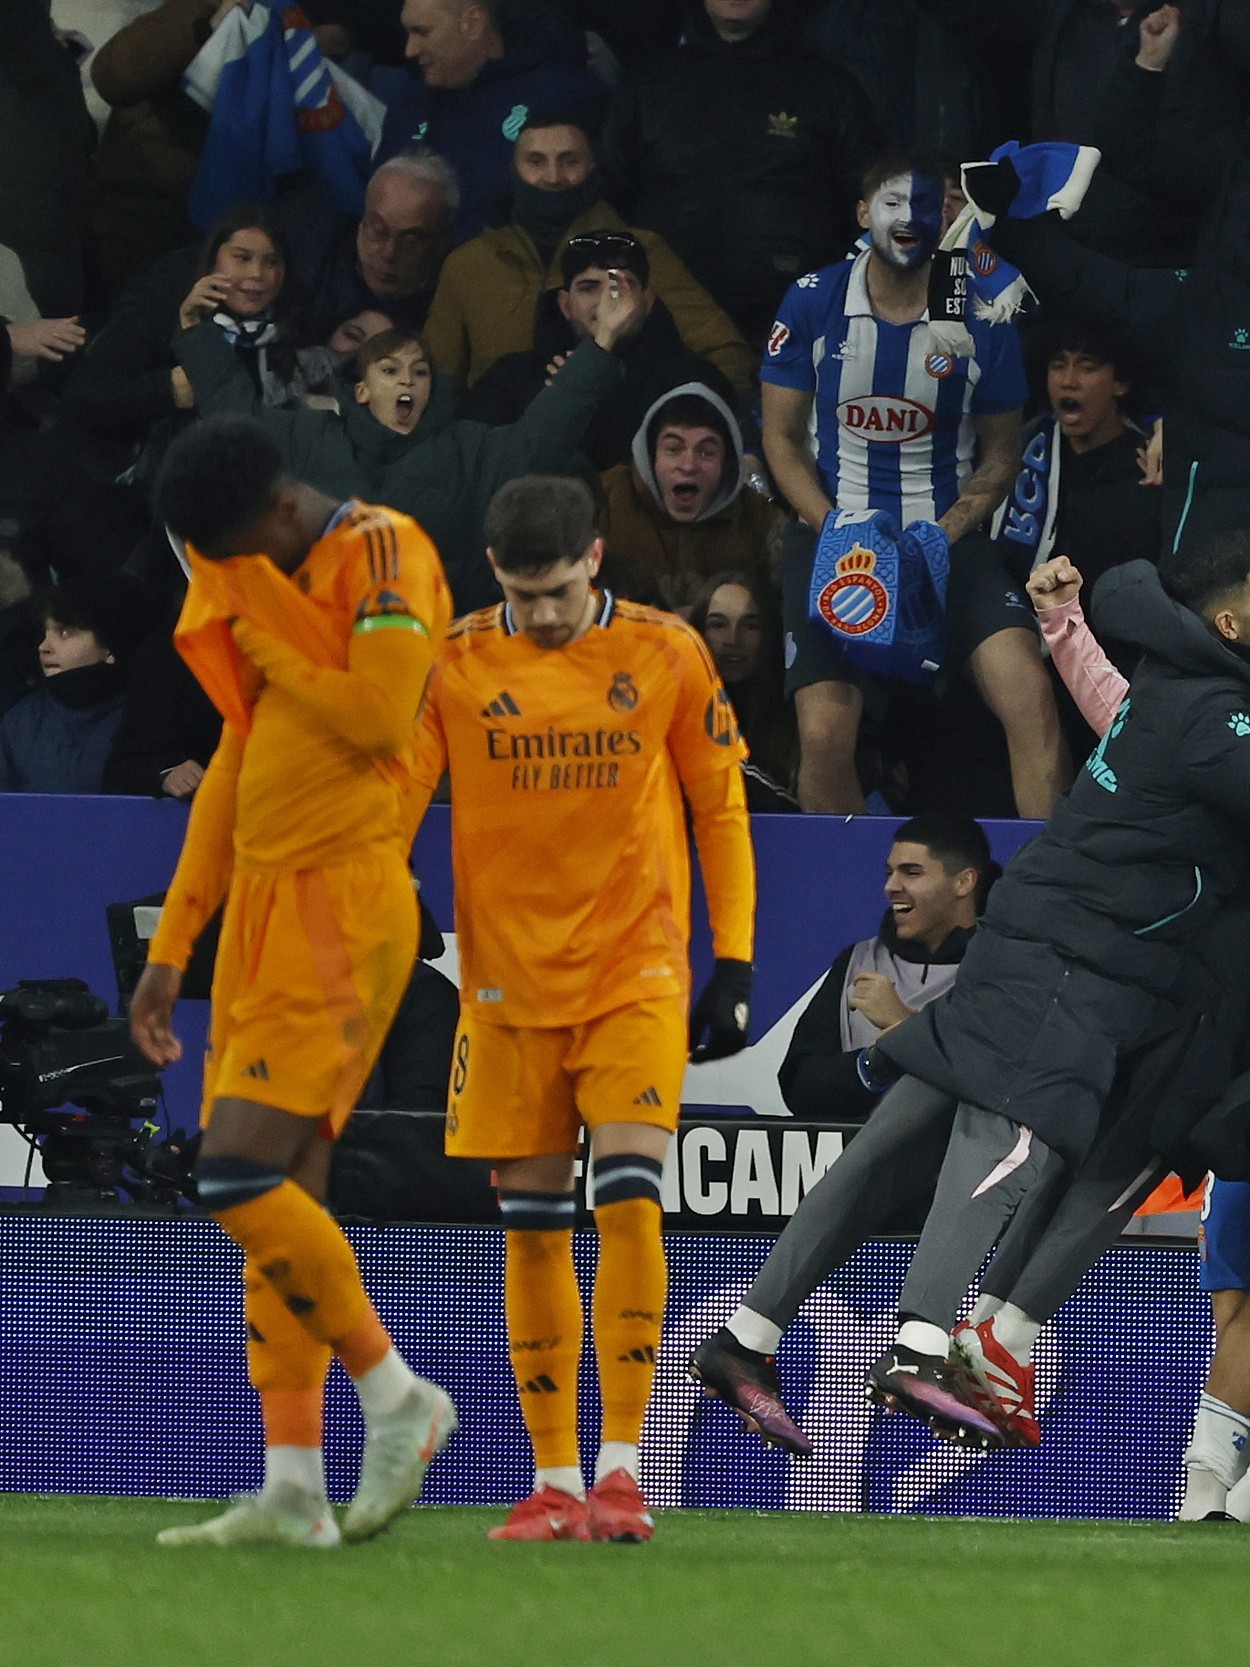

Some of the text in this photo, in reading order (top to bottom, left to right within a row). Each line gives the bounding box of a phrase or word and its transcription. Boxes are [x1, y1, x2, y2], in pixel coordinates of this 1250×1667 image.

[846, 404, 919, 433] DANI
[486, 727, 642, 760] Emirates
[512, 762, 620, 790] FLY BETTER
[457, 1034, 470, 1095] 8
